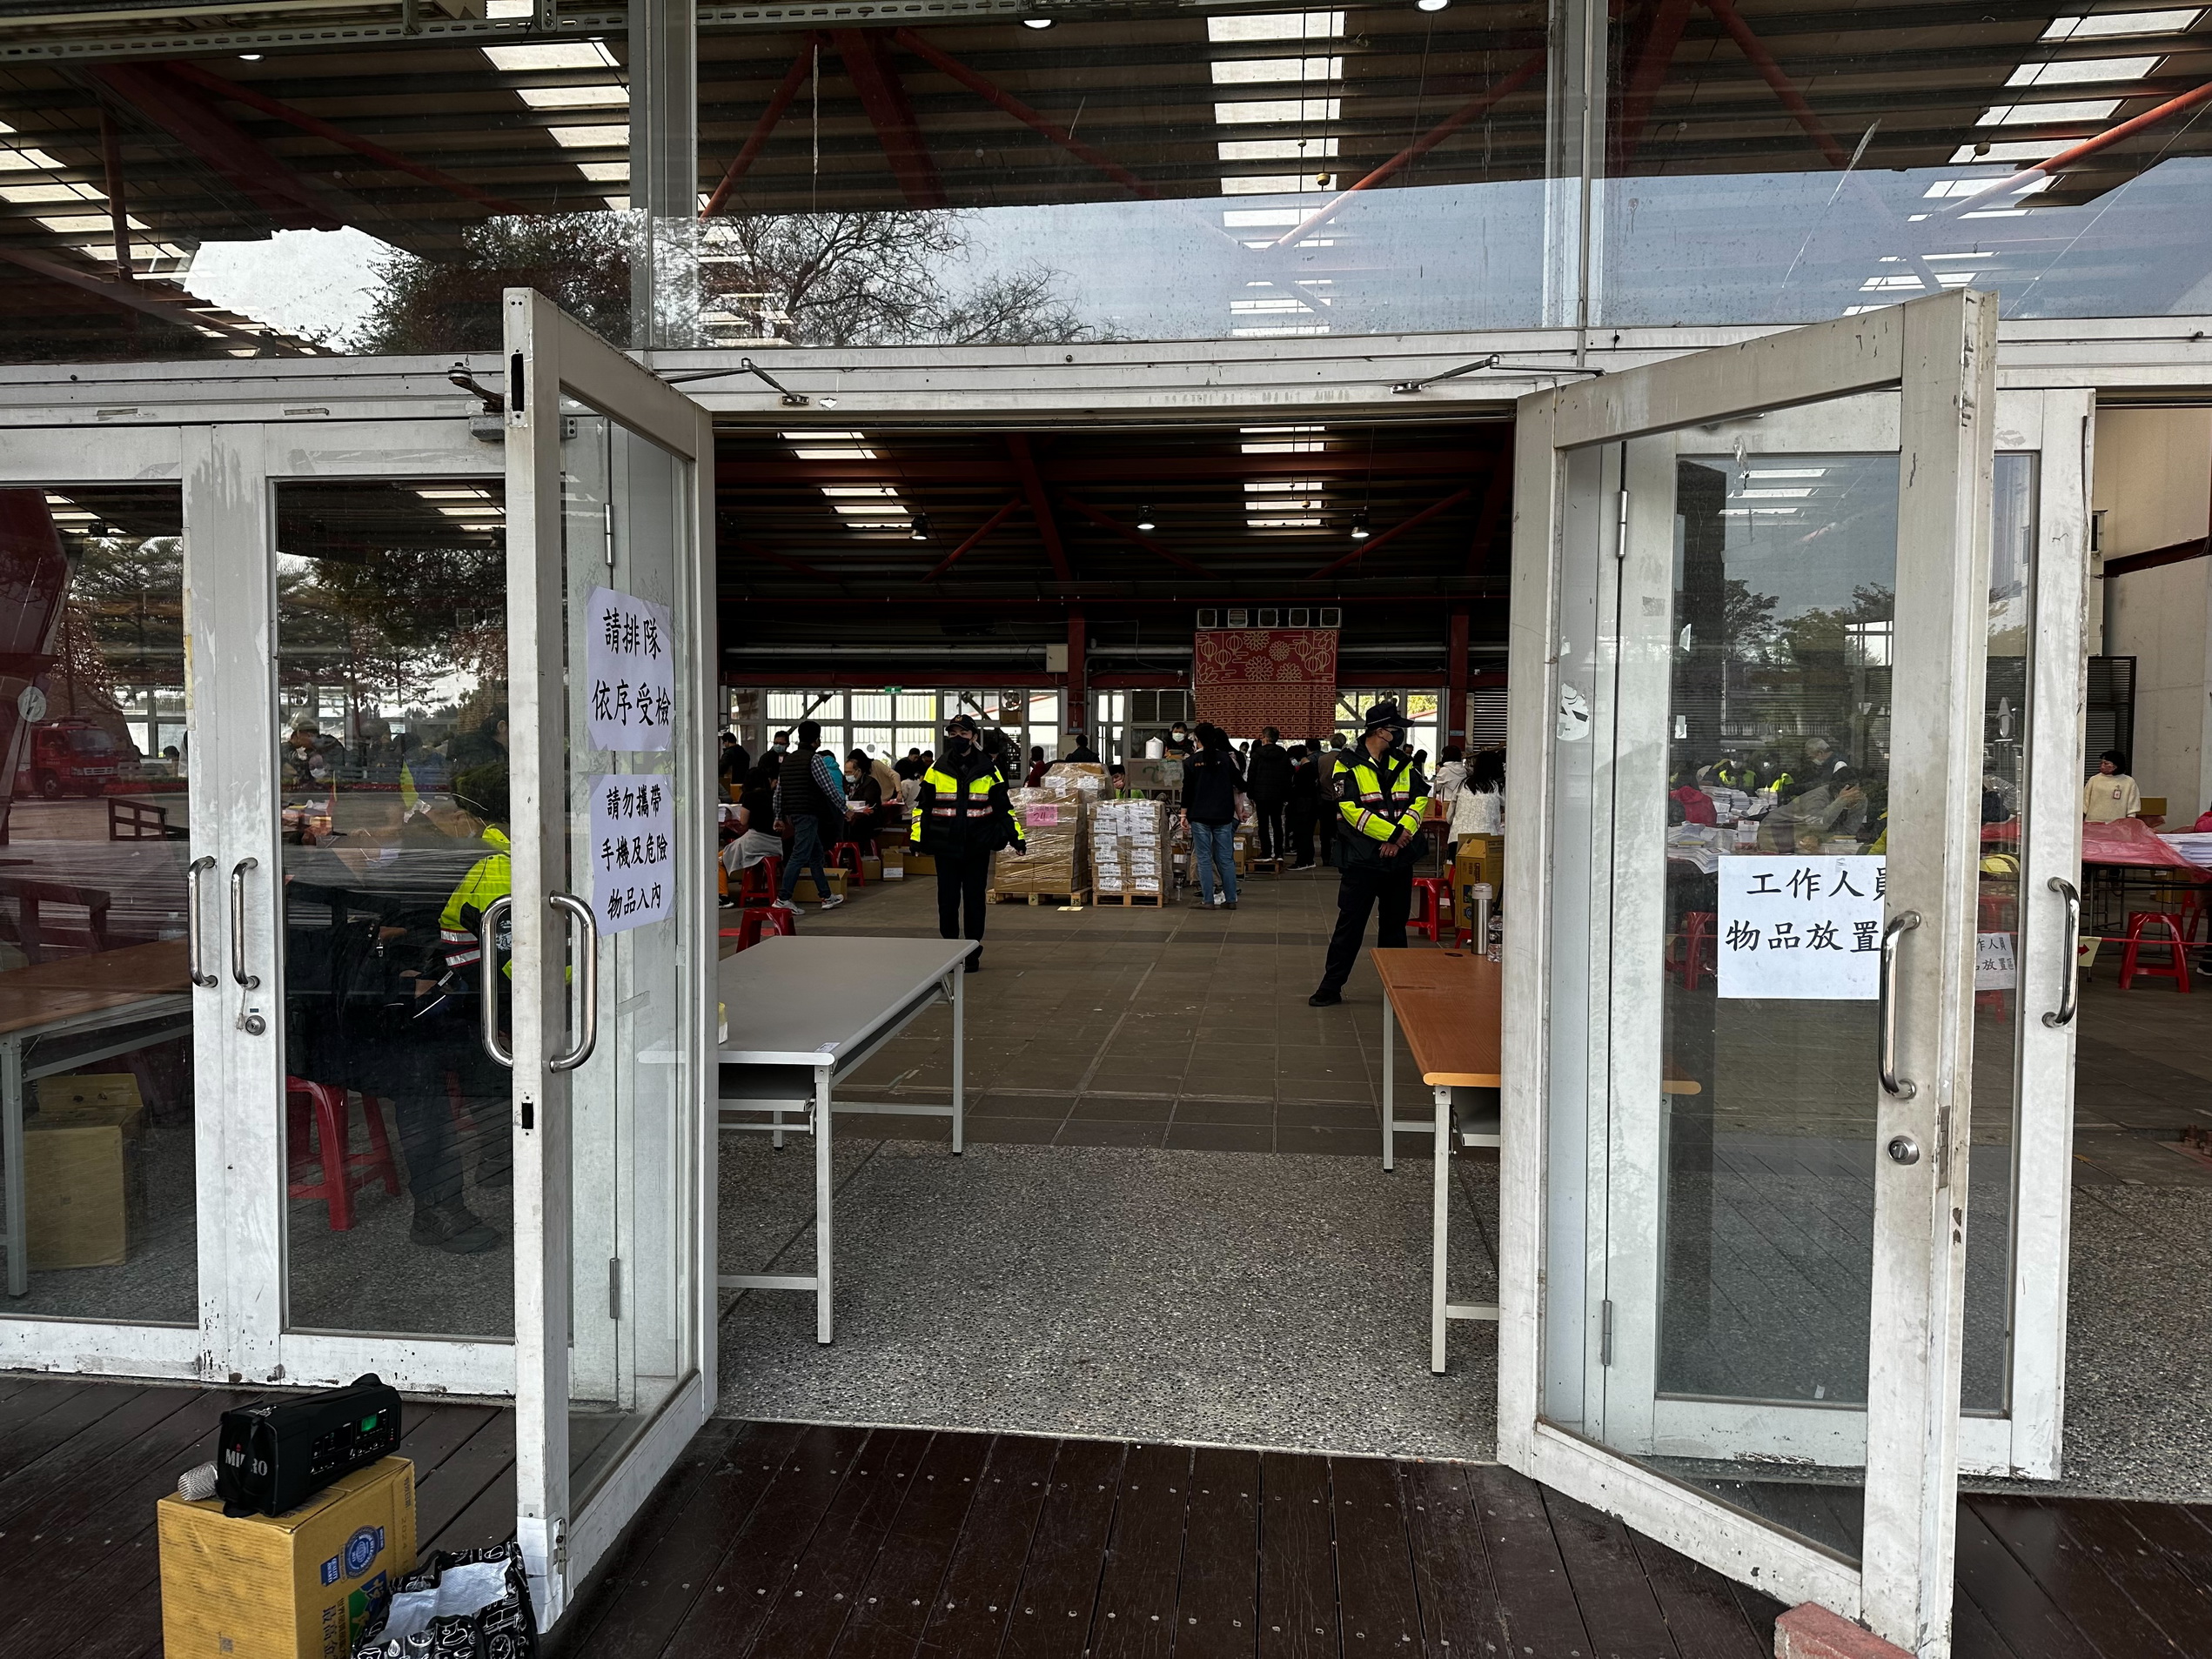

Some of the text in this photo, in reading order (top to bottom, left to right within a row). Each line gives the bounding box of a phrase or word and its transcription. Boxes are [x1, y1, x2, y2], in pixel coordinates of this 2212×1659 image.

[602, 607, 661, 660] 請排隊
[592, 679, 671, 726] 依序受檢
[607, 784, 661, 820] 請勿攜帶
[600, 833, 667, 873] 手機及危險
[607, 881, 661, 920] 物品入內
[1726, 920, 1881, 953] 物品放置
[1976, 958, 2014, 971] 放置區
[322, 1605, 338, 1659] 最高金
